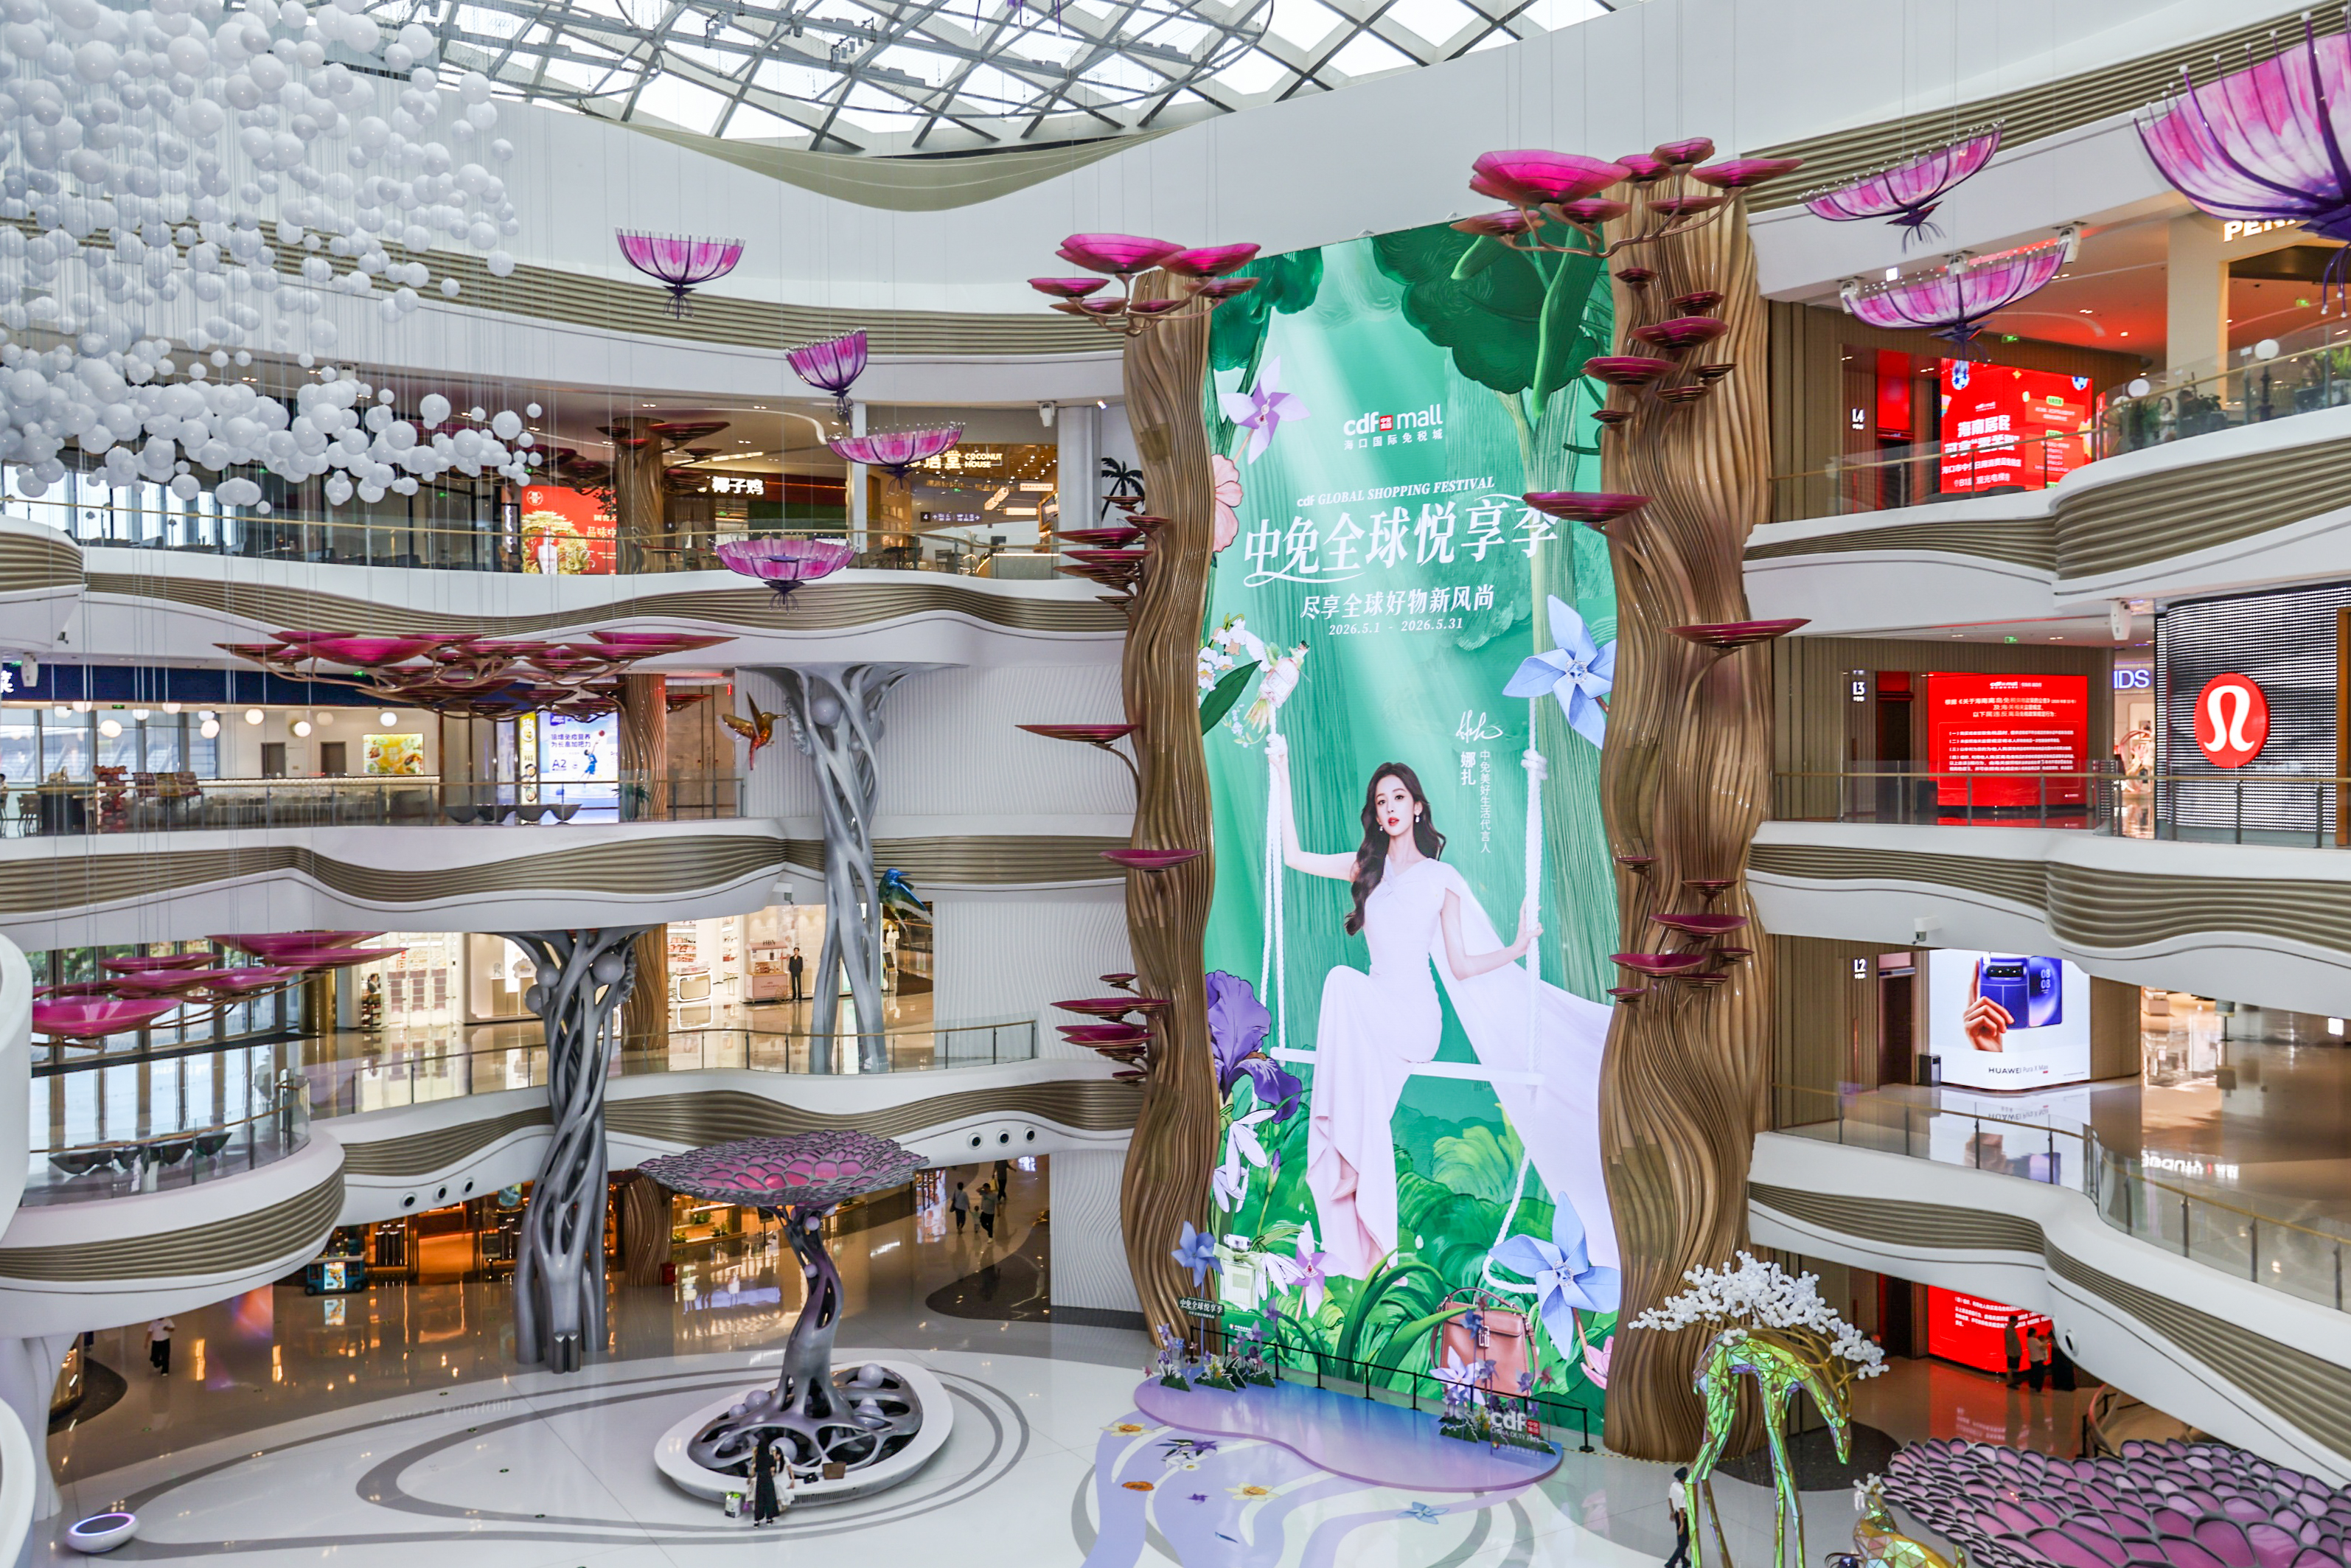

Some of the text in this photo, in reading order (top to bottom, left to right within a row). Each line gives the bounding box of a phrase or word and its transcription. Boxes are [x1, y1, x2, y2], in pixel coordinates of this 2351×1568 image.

[1343, 404, 1443, 436] cdf mall
[1852, 408, 1864, 422] L4
[1957, 414, 2010, 438] 海南居民
[1344, 428, 1443, 450] 海口国际免税城
[905, 450, 961, 469] 语堂
[697, 476, 764, 495] 椰子鸡
[1297, 476, 1495, 507] cdf GLOBAL SHOPPING FESTIVAL
[1243, 497, 1561, 582] 中免全球悦享季
[1300, 584, 1495, 620] 尽享全球好物新风尚
[1328, 622, 1381, 635] 2026.5.1
[1401, 617, 1463, 633] 2026.5.31
[1853, 681, 1865, 695] L3
[552, 759, 566, 768] A2
[1460, 750, 1476, 786] 娜扎
[1480, 750, 1491, 853] 中免美好生活代言人
[1854, 958, 1866, 972] L2
[2041, 969, 2051, 978] 08
[2041, 979, 2051, 989] 08
[1491, 1411, 1526, 1432] cdf
[1511, 1432, 1525, 1440] DUTY
